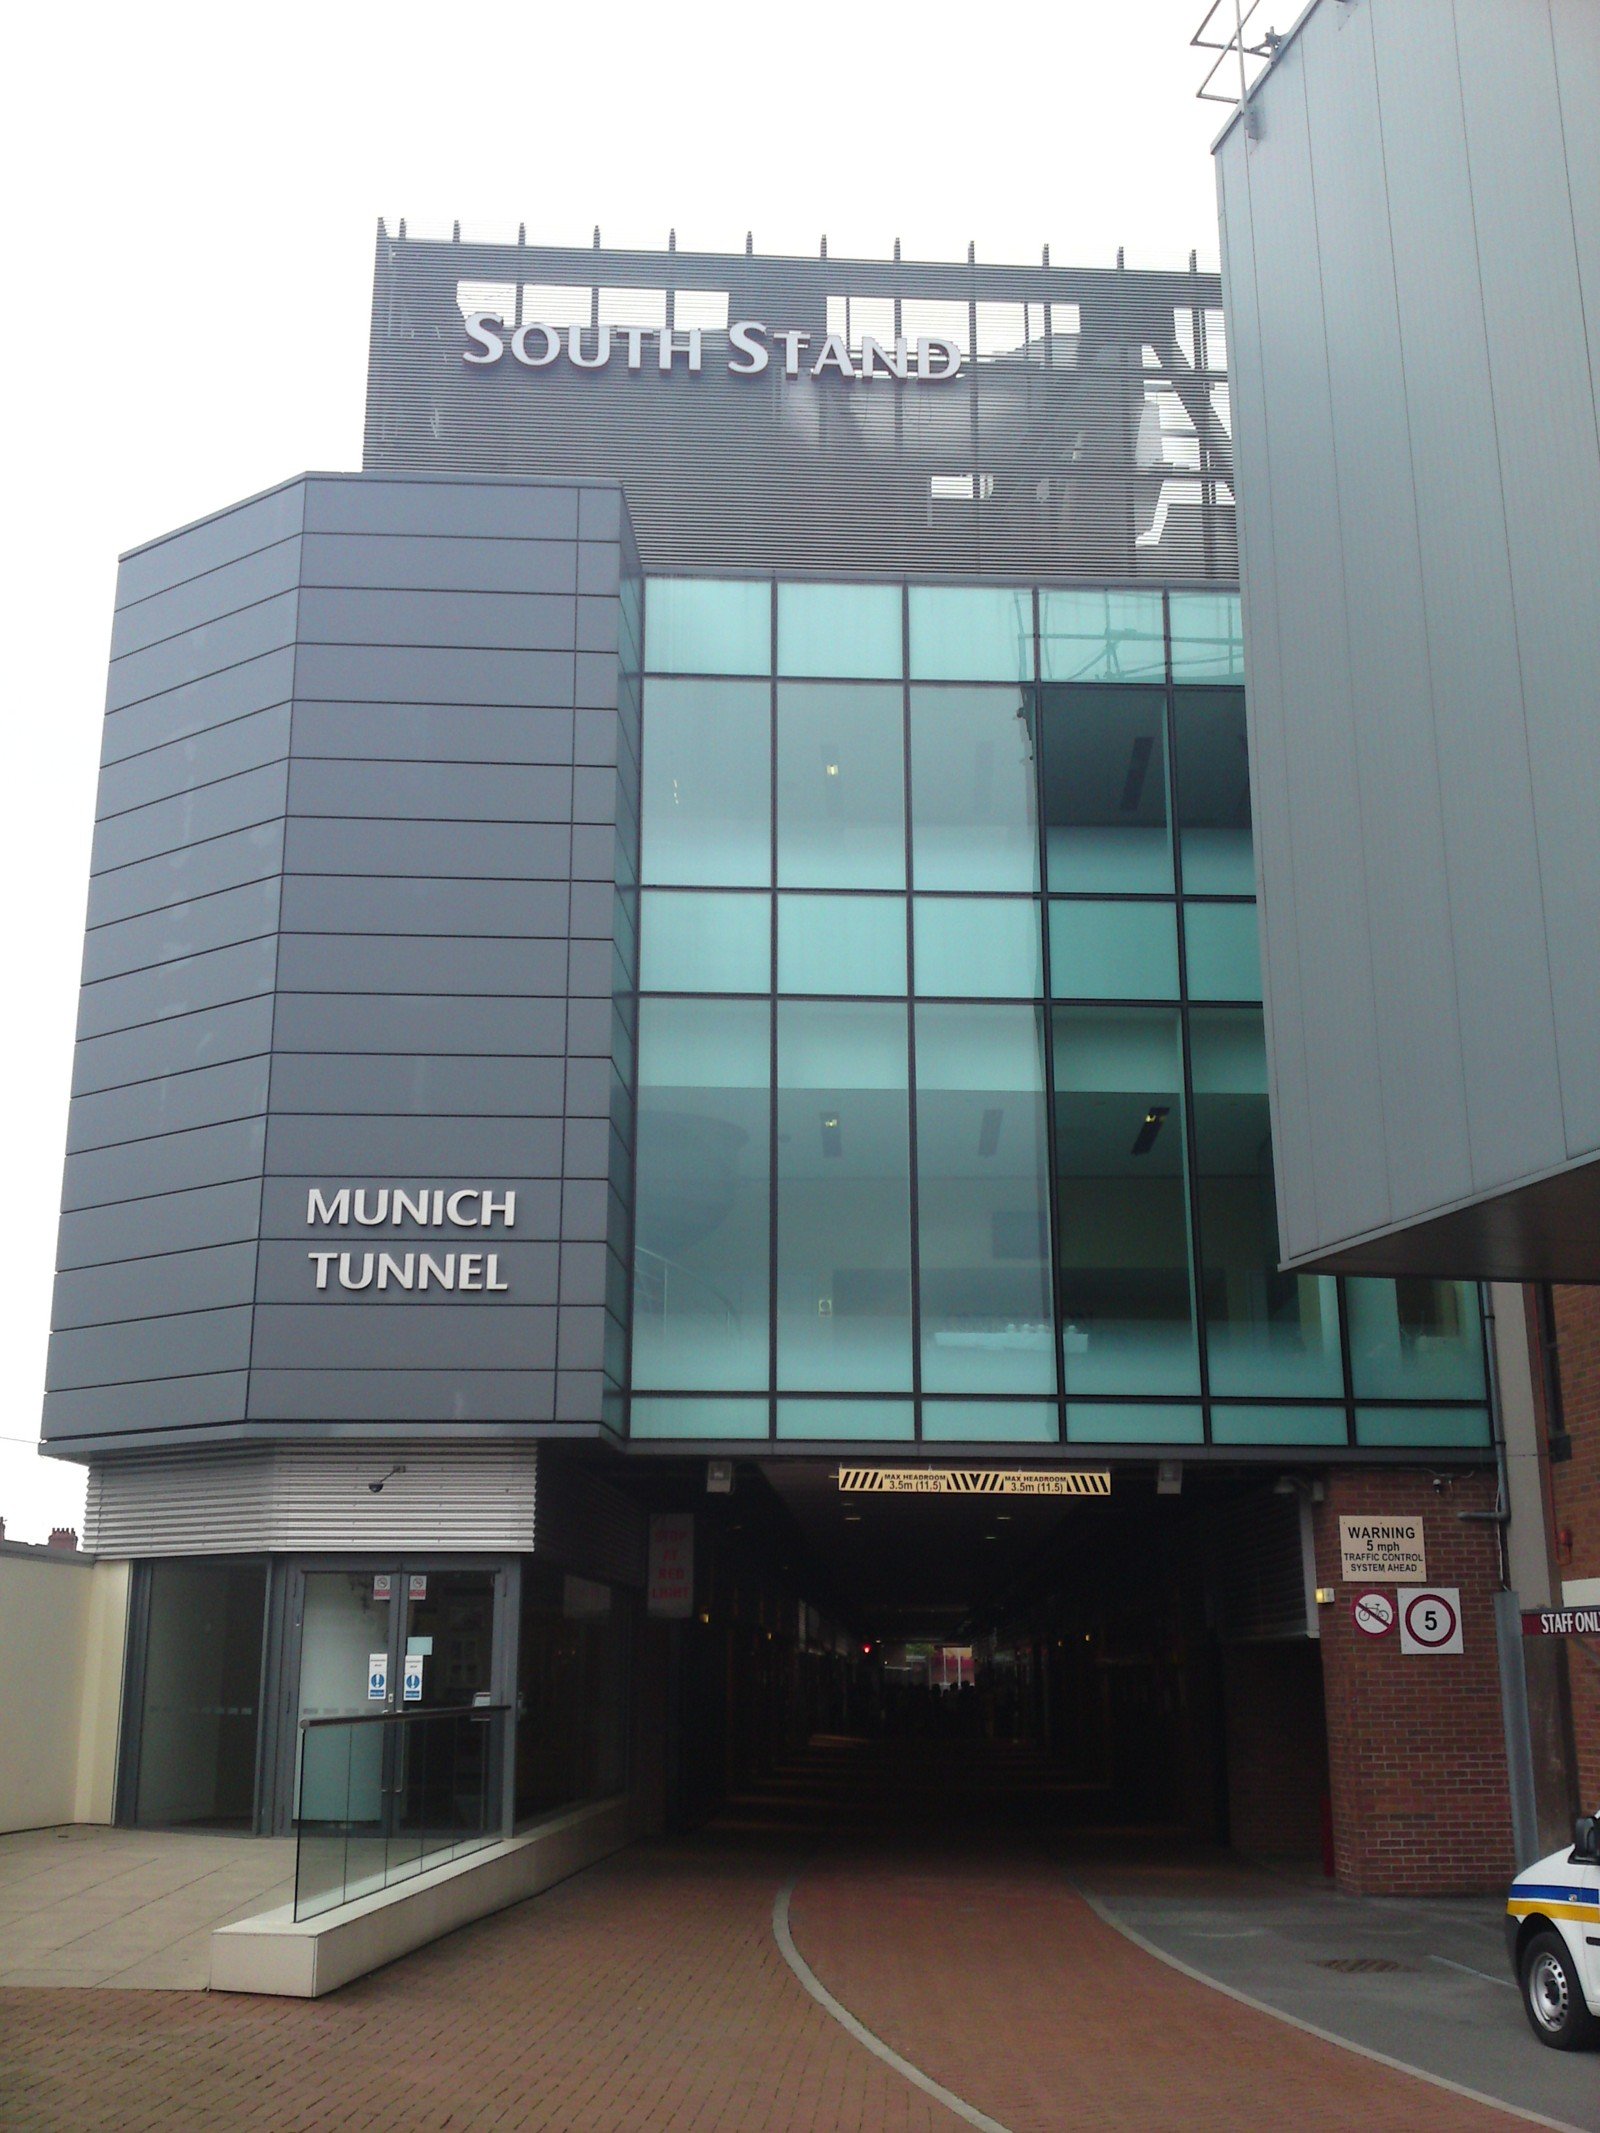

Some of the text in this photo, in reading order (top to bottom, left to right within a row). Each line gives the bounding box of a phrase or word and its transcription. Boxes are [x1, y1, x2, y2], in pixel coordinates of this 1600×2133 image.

[462, 311, 962, 380] SOUTH STAND
[306, 1188, 516, 1227] MUNICH
[308, 1252, 508, 1290] TUNNEL
[889, 1480, 941, 1492] 3.5m (11.5)
[1011, 1482, 1064, 1494] 3.5m (11.5)
[1347, 1526, 1416, 1539] WARNING
[1366, 1539, 1400, 1553] 5 mph
[1343, 1552, 1424, 1562] TRAFFIC CONTROL
[1350, 1563, 1418, 1572] SYSTEM AHEAD
[1424, 1610, 1438, 1631] 5
[1541, 1611, 1600, 1634] STAFF ONL
